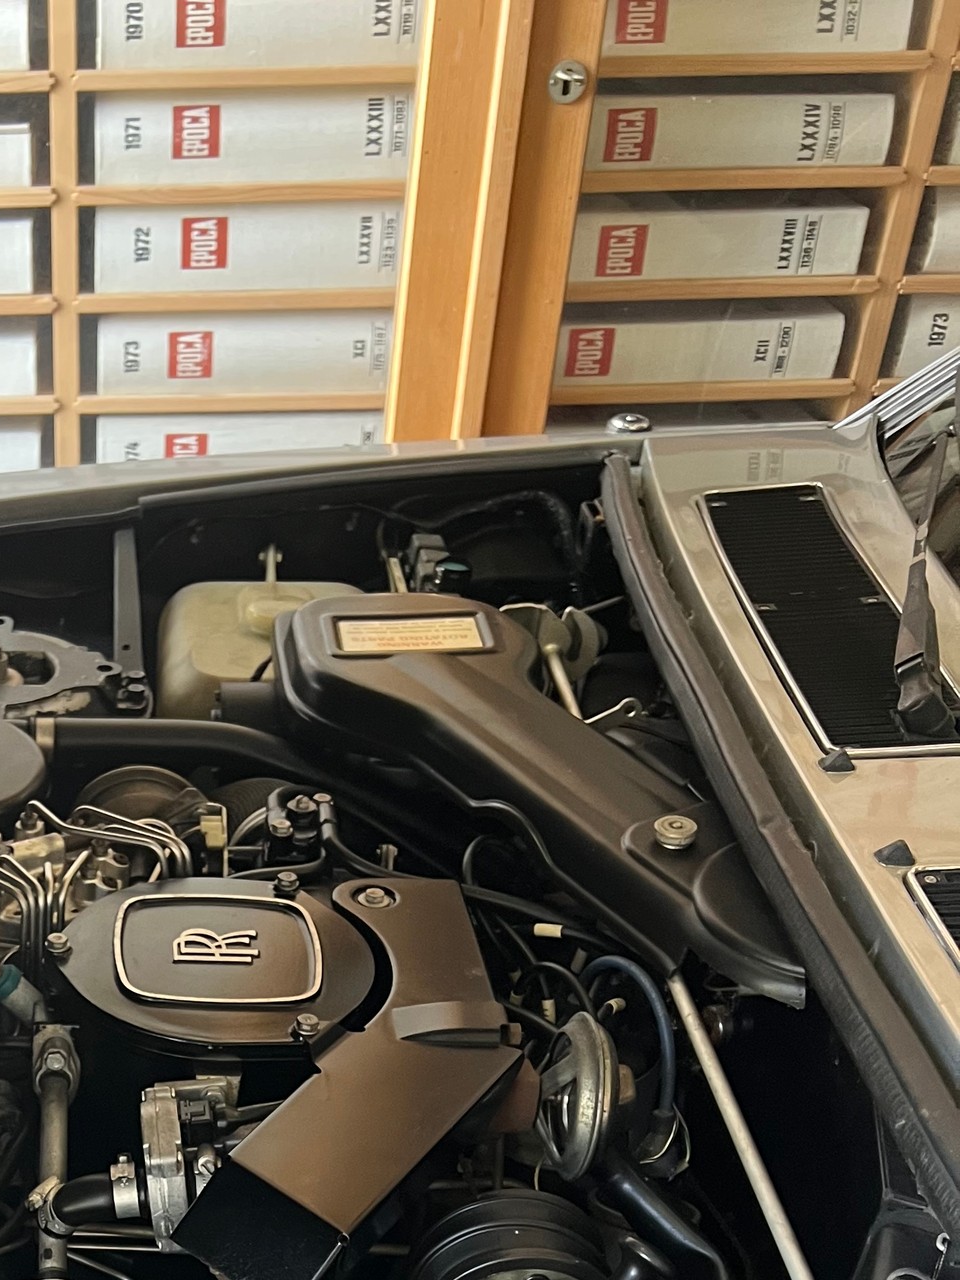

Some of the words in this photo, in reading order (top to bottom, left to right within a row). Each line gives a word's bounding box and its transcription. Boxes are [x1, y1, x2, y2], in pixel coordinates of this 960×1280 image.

[126, 2, 144, 41] 1970
[124, 117, 142, 150] 1971
[181, 106, 211, 158] EPOCA
[364, 97, 384, 156] LXXXIII
[613, 110, 646, 161] EPOCA
[797, 104, 821, 162] LXXXIV
[133, 227, 152, 263] 1972
[190, 218, 218, 268] EPOCA
[606, 226, 639, 275] EPOCA
[776, 218, 798, 270] LXXXVIII
[574, 330, 605, 375] EPOCA
[753, 339, 770, 362] XCII
[928, 313, 950, 347] 1973
[124, 341, 140, 373] 1973
[176, 333, 204, 378] EPOCA
